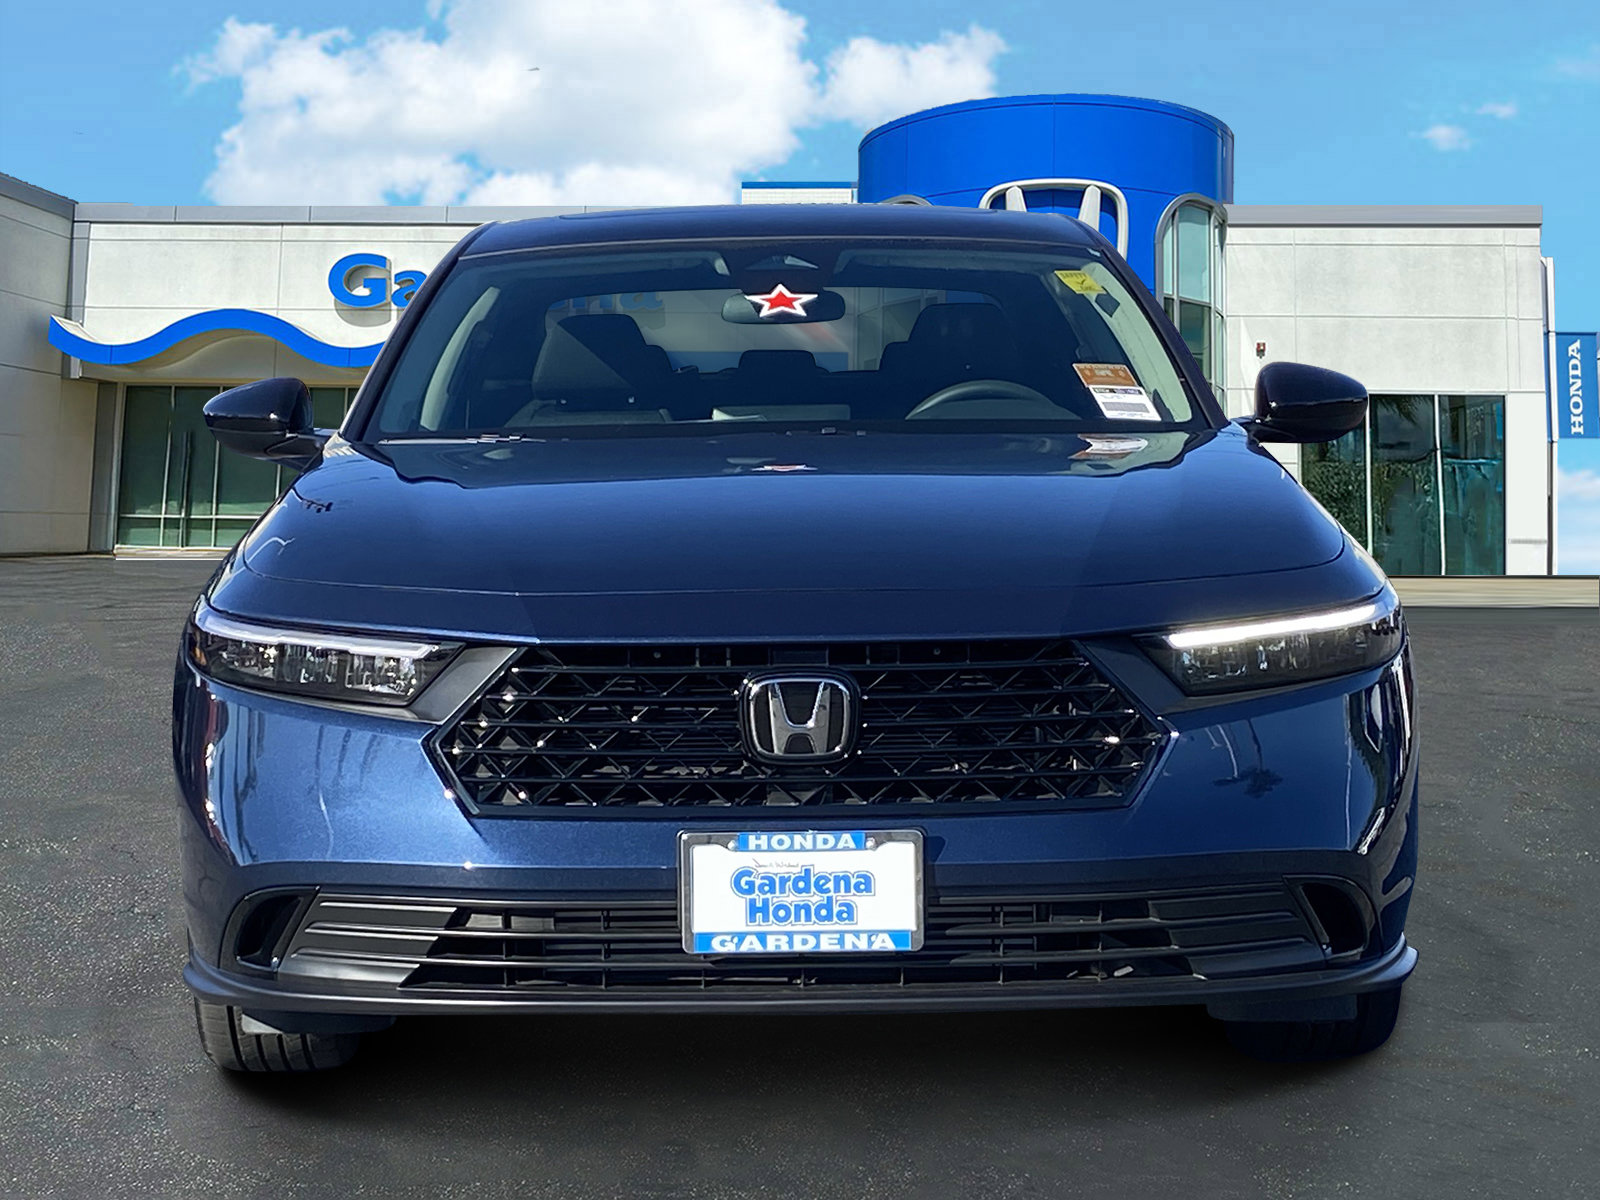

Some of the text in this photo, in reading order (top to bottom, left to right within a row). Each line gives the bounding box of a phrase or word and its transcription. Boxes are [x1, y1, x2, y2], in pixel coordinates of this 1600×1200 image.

[1568, 339, 1584, 435] HONDA
[748, 833, 857, 850] HONDA
[732, 866, 873, 897] Gardena
[748, 896, 856, 924] Honda
[710, 932, 897, 951] GARDENA
